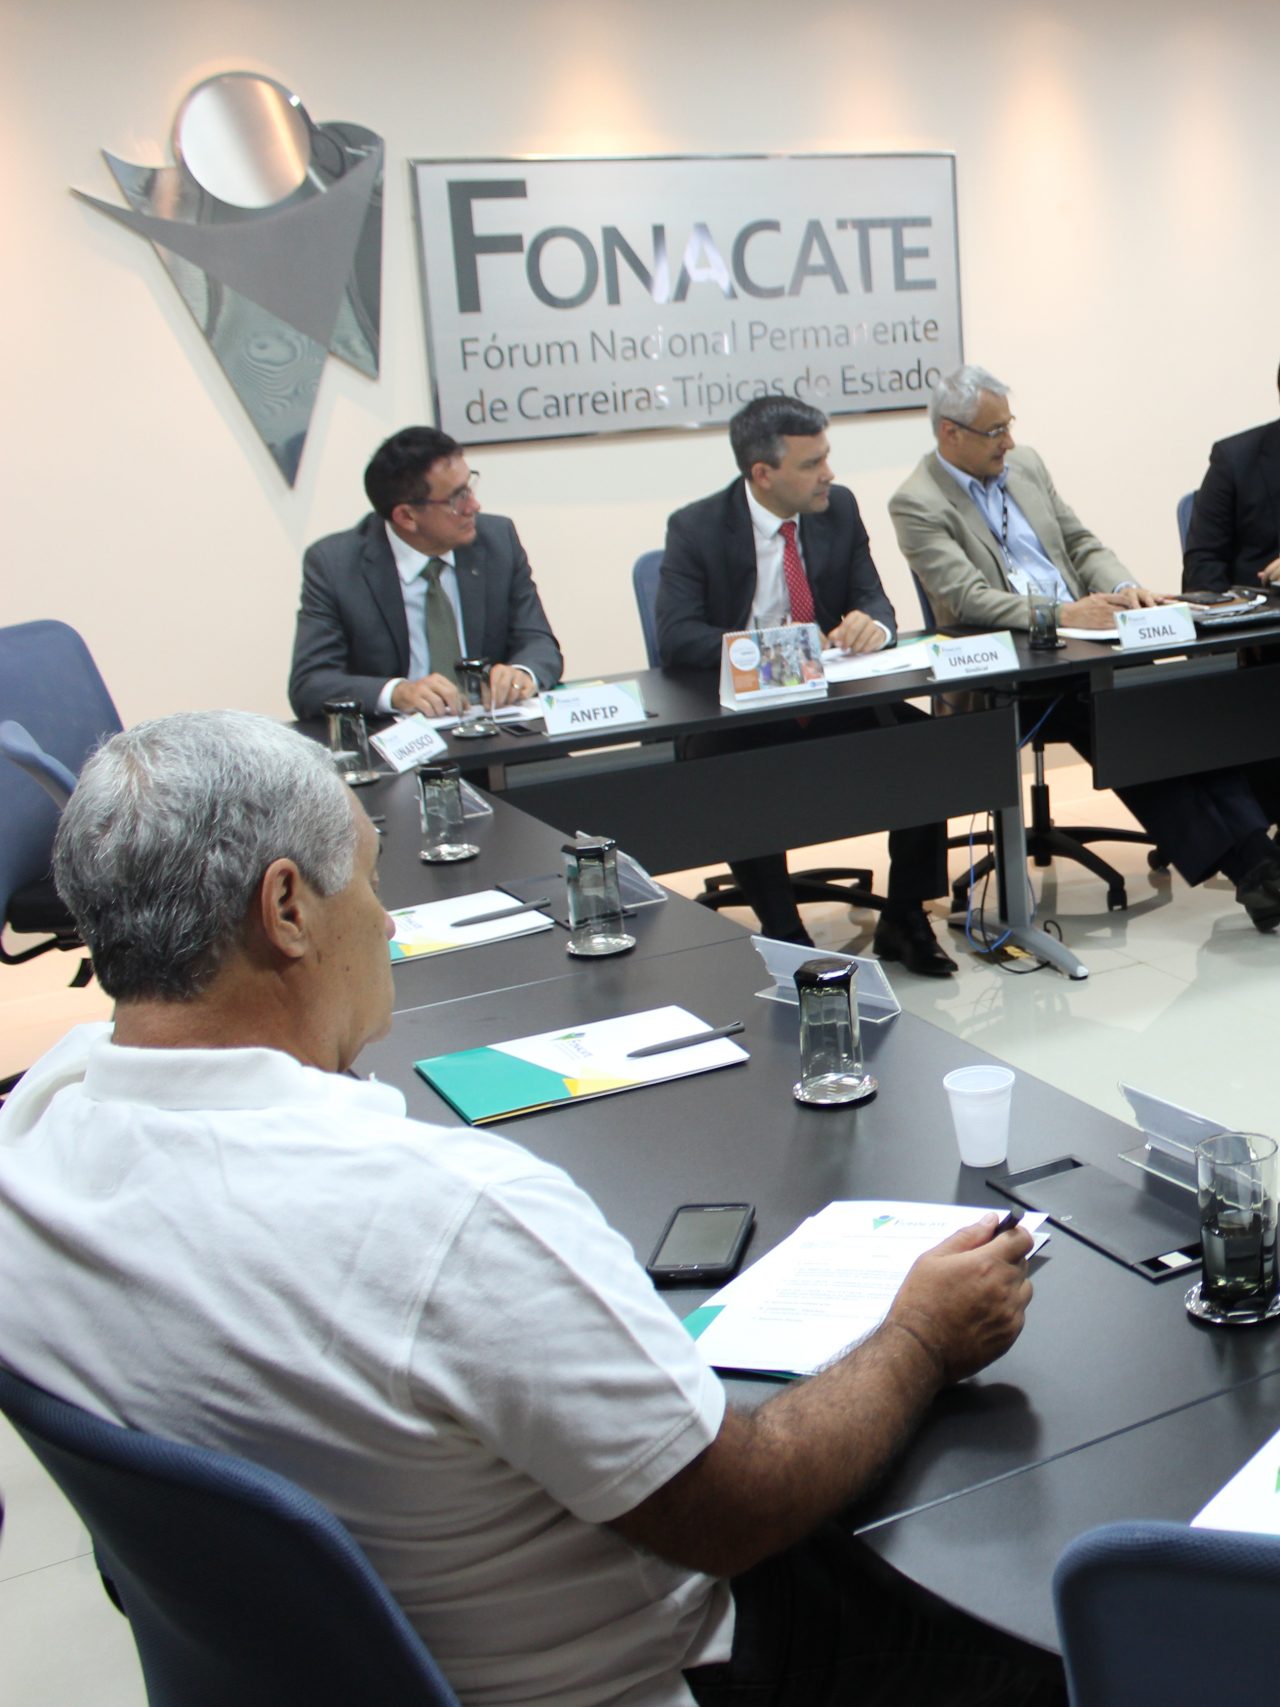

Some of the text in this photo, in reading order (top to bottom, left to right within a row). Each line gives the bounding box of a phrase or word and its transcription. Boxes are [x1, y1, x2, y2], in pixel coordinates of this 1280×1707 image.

[446, 178, 938, 314] FONACATE
[460, 315, 939, 371] Fórum Nacional Permanente
[465, 358, 942, 425] de Carreiras Típicas do Estado
[1138, 624, 1176, 640] SINAL
[948, 650, 998, 667] UNACON
[570, 705, 619, 724] ANFIP
[393, 734, 435, 760] UNAFISCO
